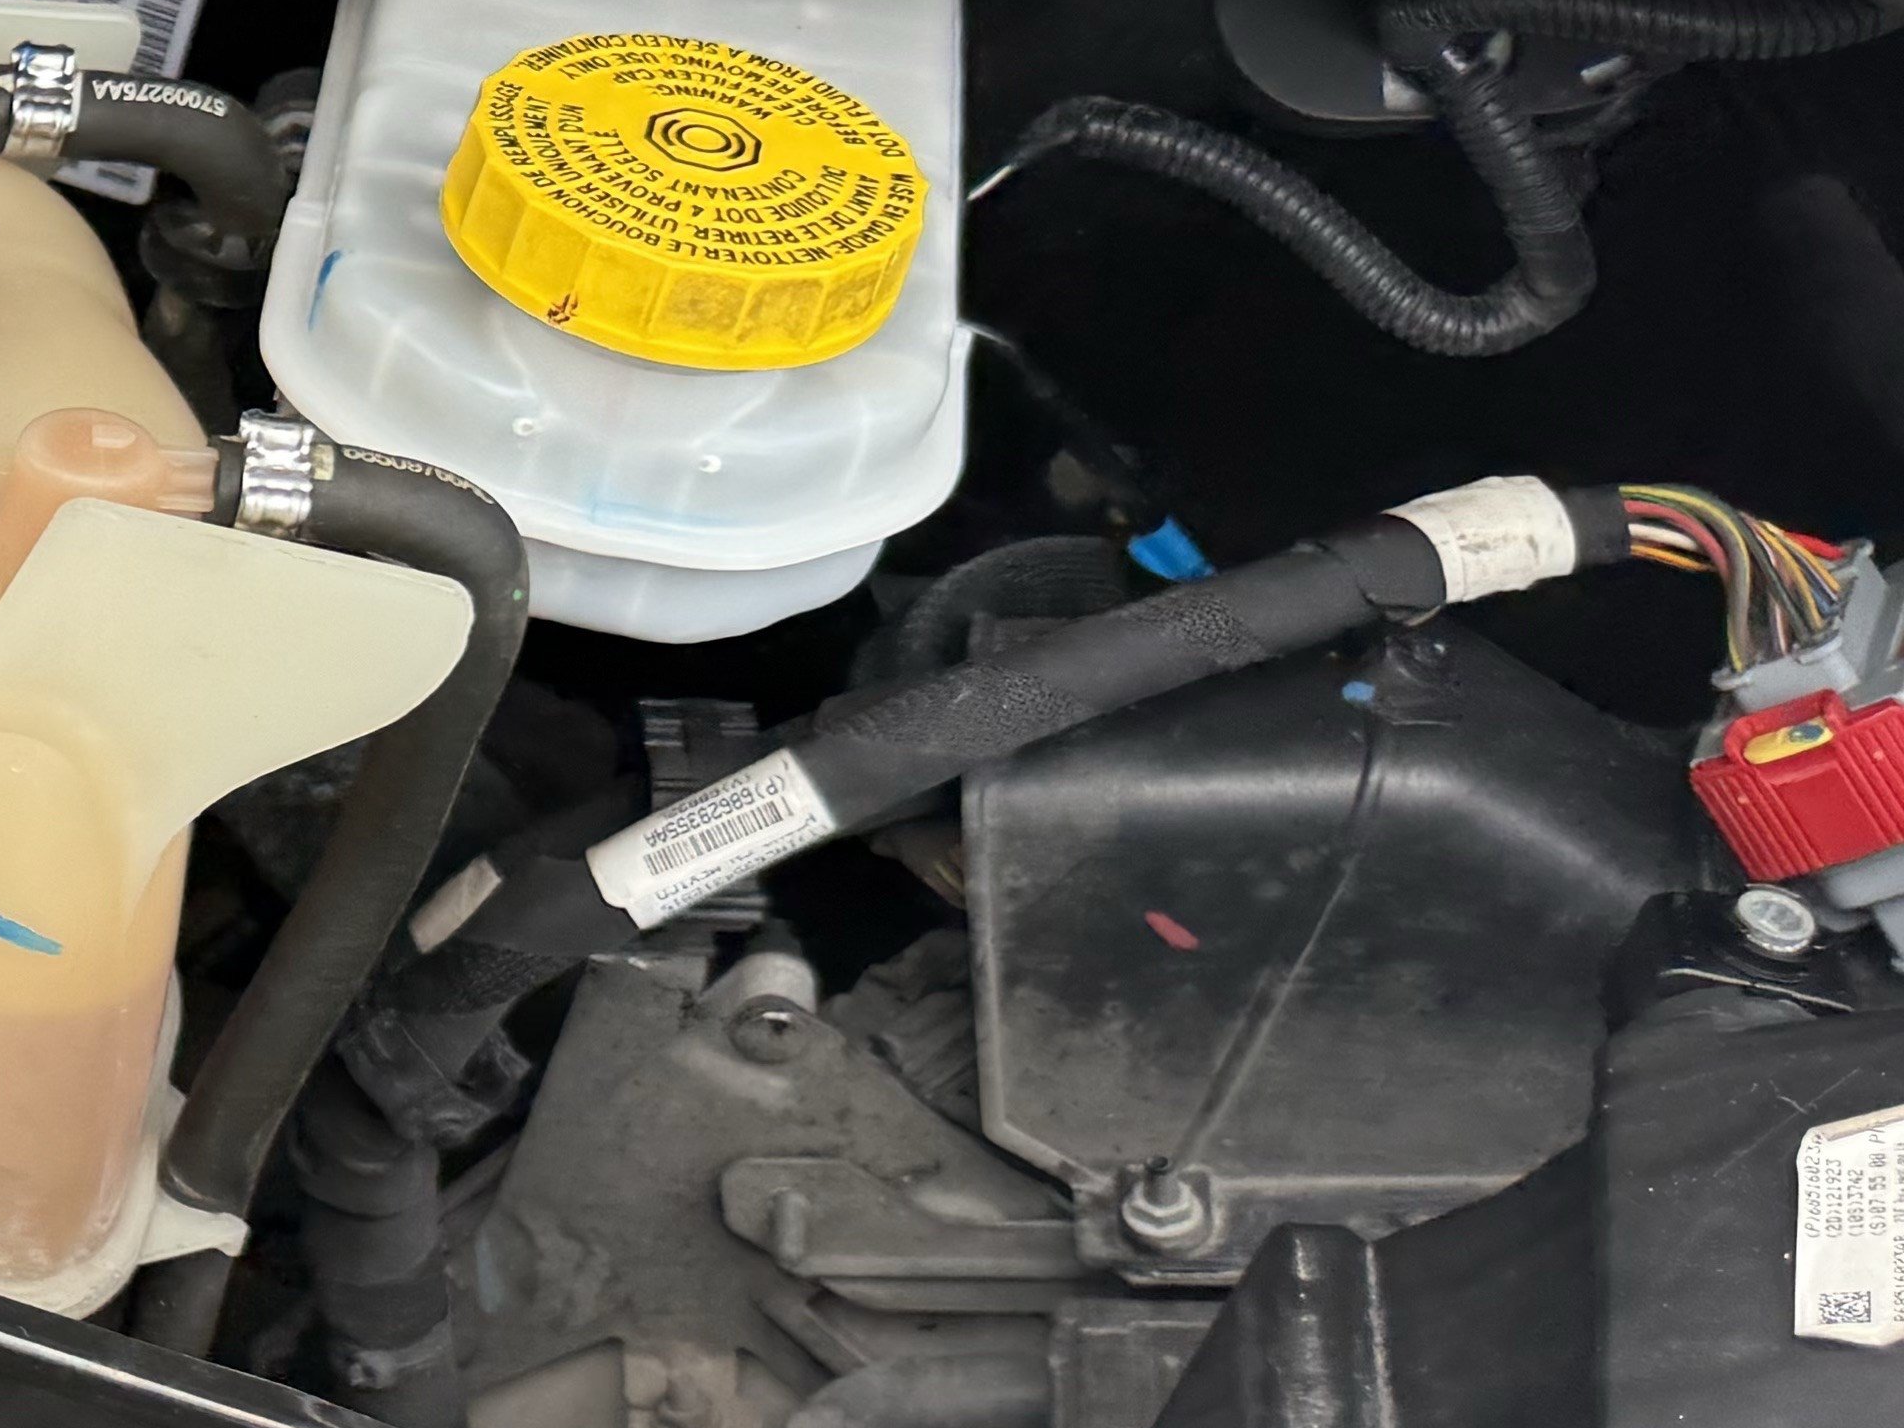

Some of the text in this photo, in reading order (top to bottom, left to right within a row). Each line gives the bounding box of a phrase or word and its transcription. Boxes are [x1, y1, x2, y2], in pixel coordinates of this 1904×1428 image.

[611, 51, 660, 66] USE
[631, 34, 720, 56] SEALED
[728, 46, 744, 59] A
[558, 55, 611, 81] ONLY
[747, 54, 815, 86] FROM
[612, 68, 817, 126] CLEAN FILLER CAP
[811, 81, 871, 118] FLUID
[488, 79, 535, 166] REMPLISSAGE
[792, 95, 868, 146] BEFORE
[522, 95, 585, 183] UNIQUEMENT
[866, 131, 906, 159] DOT
[520, 169, 557, 189] DE
[563, 138, 682, 213] PROVENANT
[664, 169, 807, 203] CONTENANT
[820, 164, 848, 184] DU
[887, 172, 916, 204] MISE
[576, 181, 679, 234] UTILISER
[769, 180, 836, 223] LIQUIDE
[847, 172, 881, 217] AVANT
[545, 189, 661, 247] BOUCHON
[713, 207, 766, 224] DOT
[820, 209, 856, 232] DE
[878, 203, 911, 223] EN
[795, 219, 827, 241] LE
[665, 239, 696, 257] LE
[703, 245, 834, 266] NETTOYER
